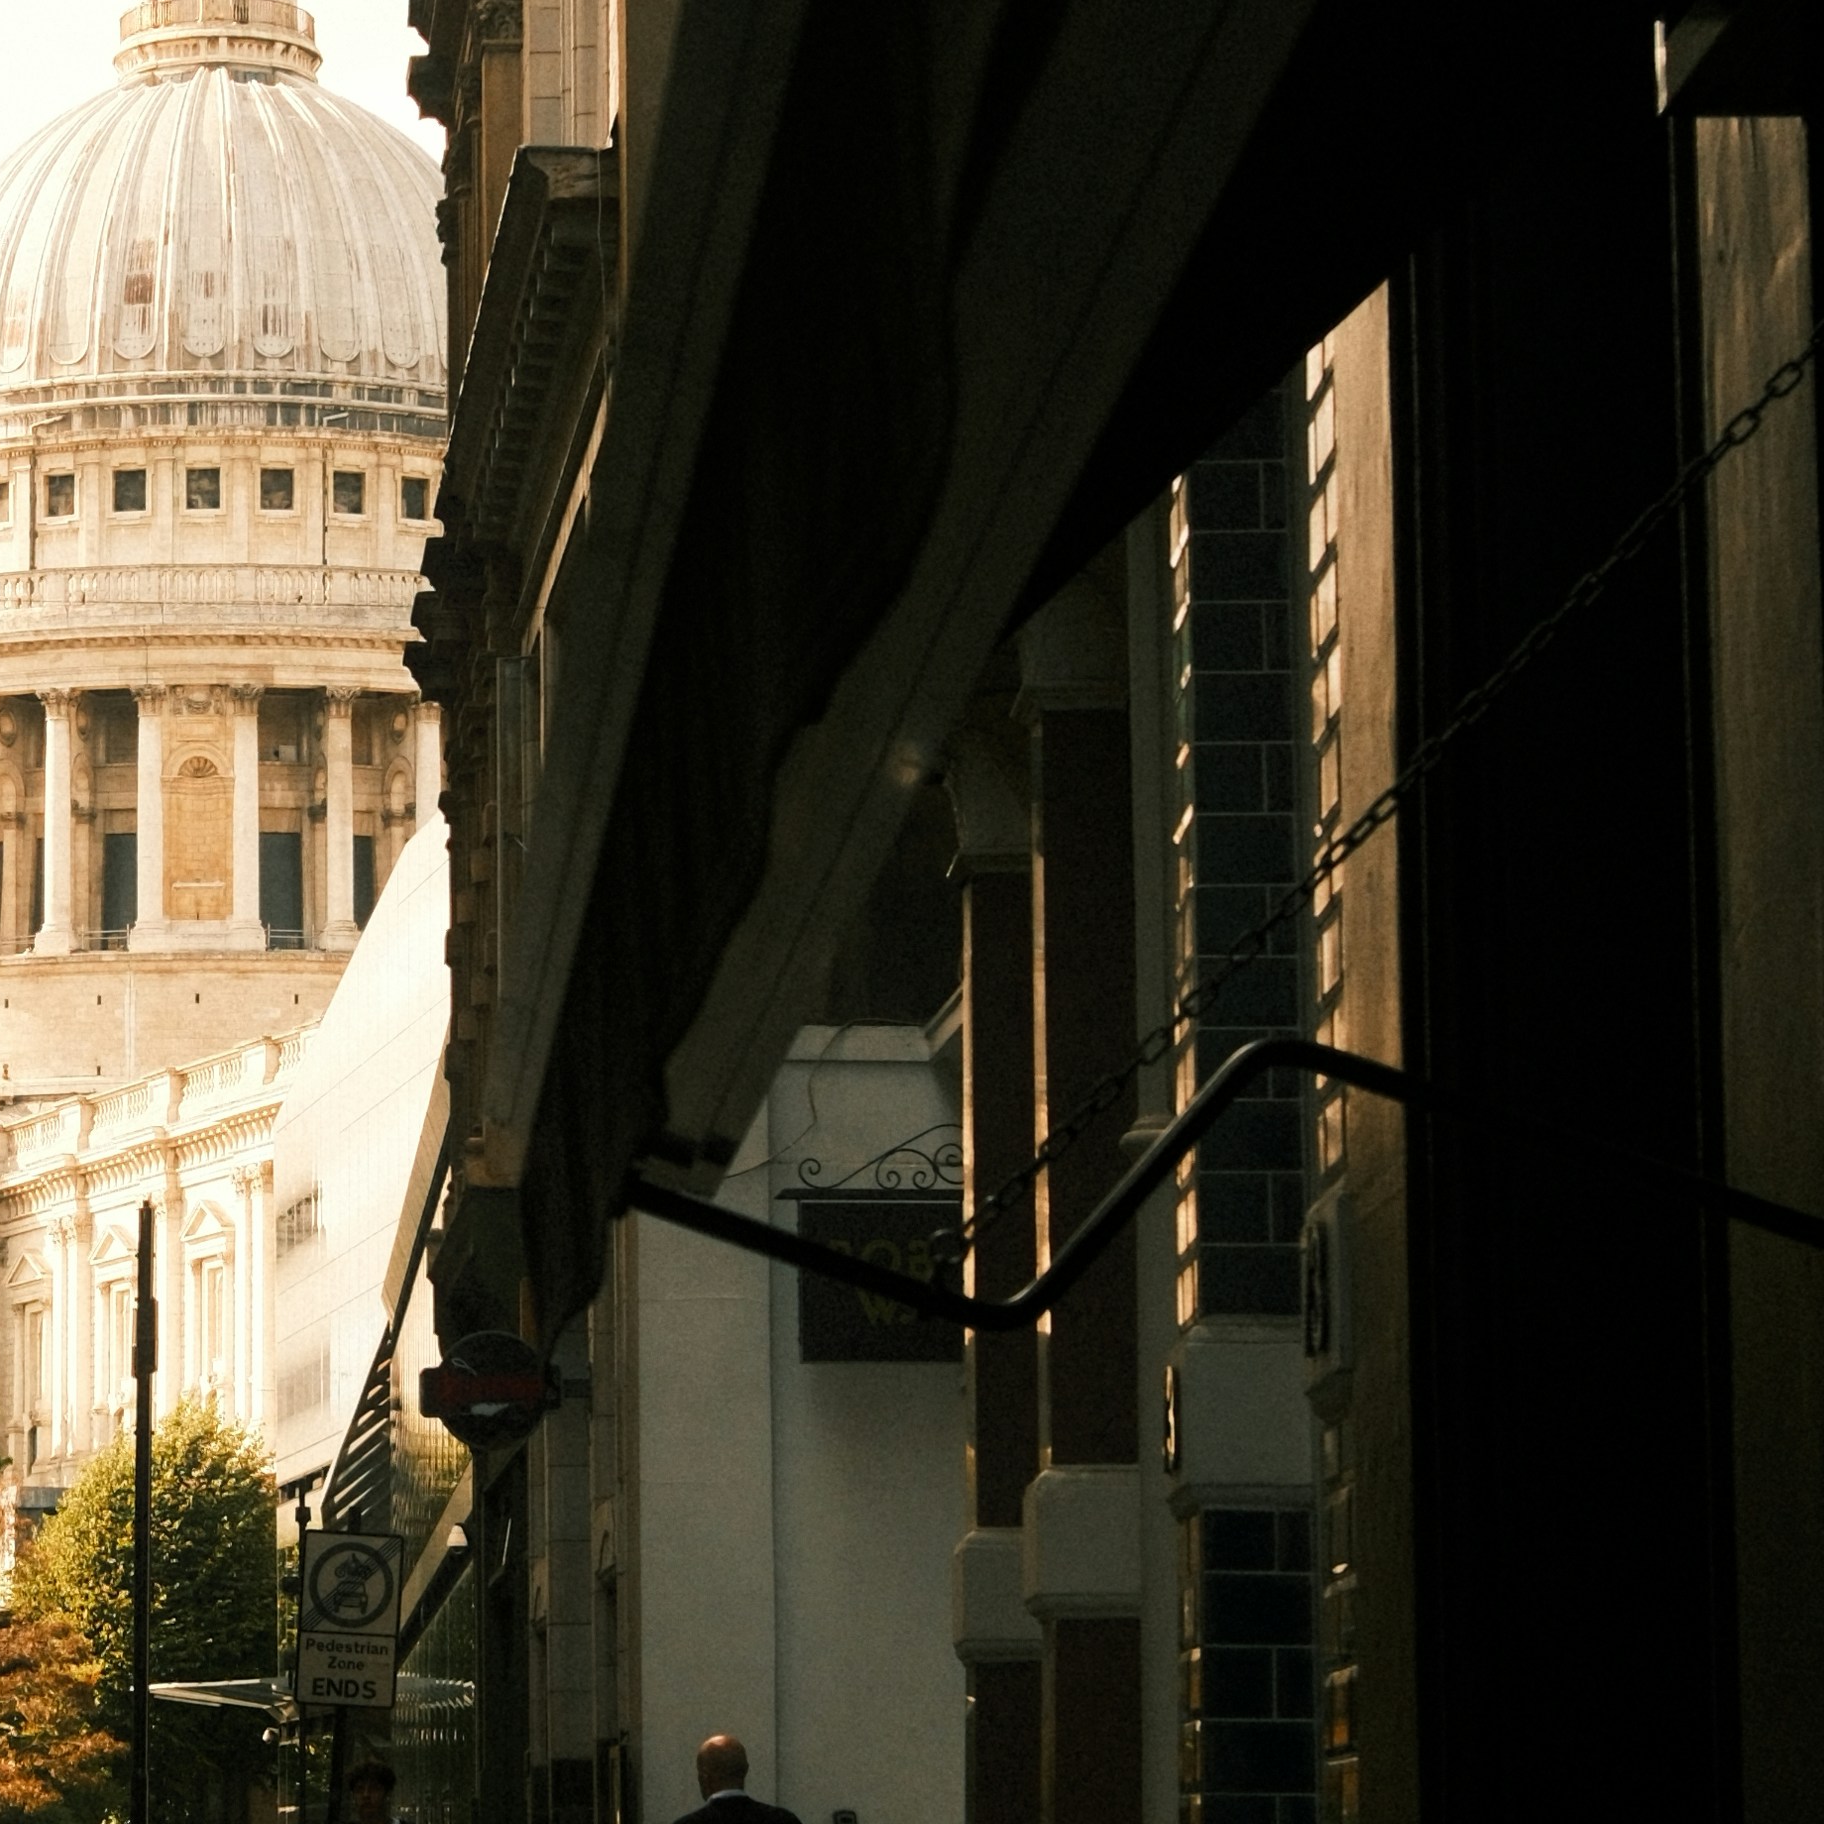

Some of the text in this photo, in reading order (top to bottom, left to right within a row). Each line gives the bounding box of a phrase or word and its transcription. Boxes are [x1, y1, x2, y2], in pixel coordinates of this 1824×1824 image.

[828, 1238, 934, 1283] OB
[305, 1637, 389, 1655] Pedestrian
[327, 1656, 365, 1671] Zone
[312, 1677, 377, 1699] ENDS
